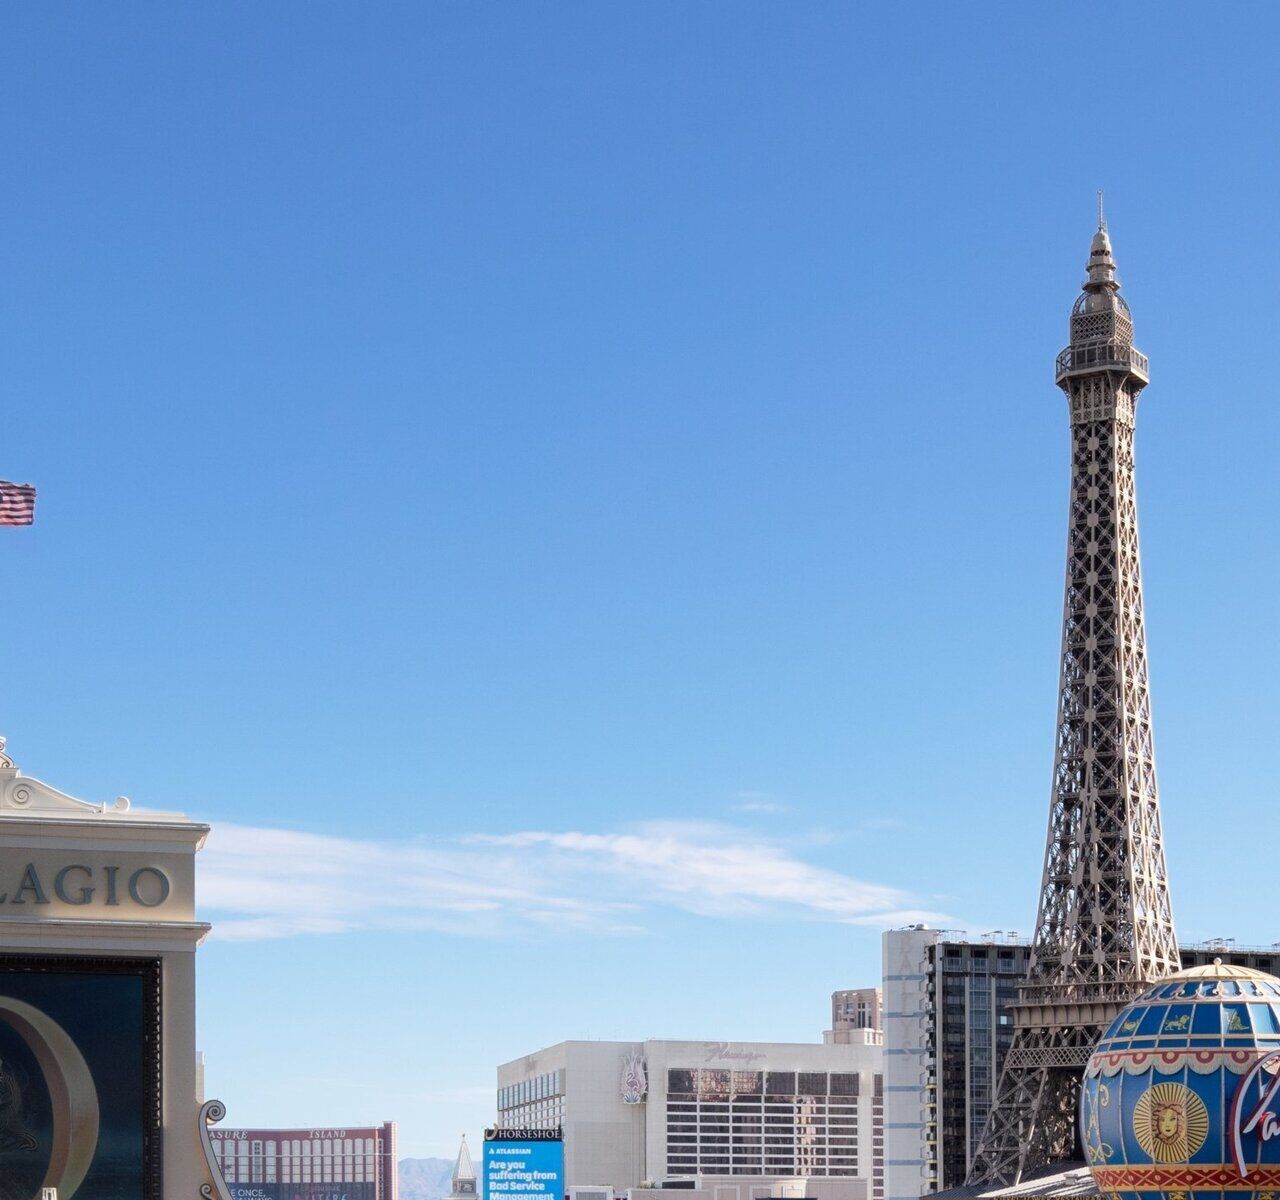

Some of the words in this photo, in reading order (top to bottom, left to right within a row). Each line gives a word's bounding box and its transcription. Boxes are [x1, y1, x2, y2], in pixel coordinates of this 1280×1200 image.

[309, 1130, 346, 1139] ISLAND
[498, 1130, 560, 1139] HORSESHOE
[489, 1160, 507, 1169] Are
[507, 1161, 526, 1172] you
[489, 1171, 533, 1182] suffering
[533, 1171, 557, 1180] from
[489, 1181, 509, 1191] Bad
[509, 1181, 545, 1191] Service
[237, 1189, 266, 1198] ONCE,
